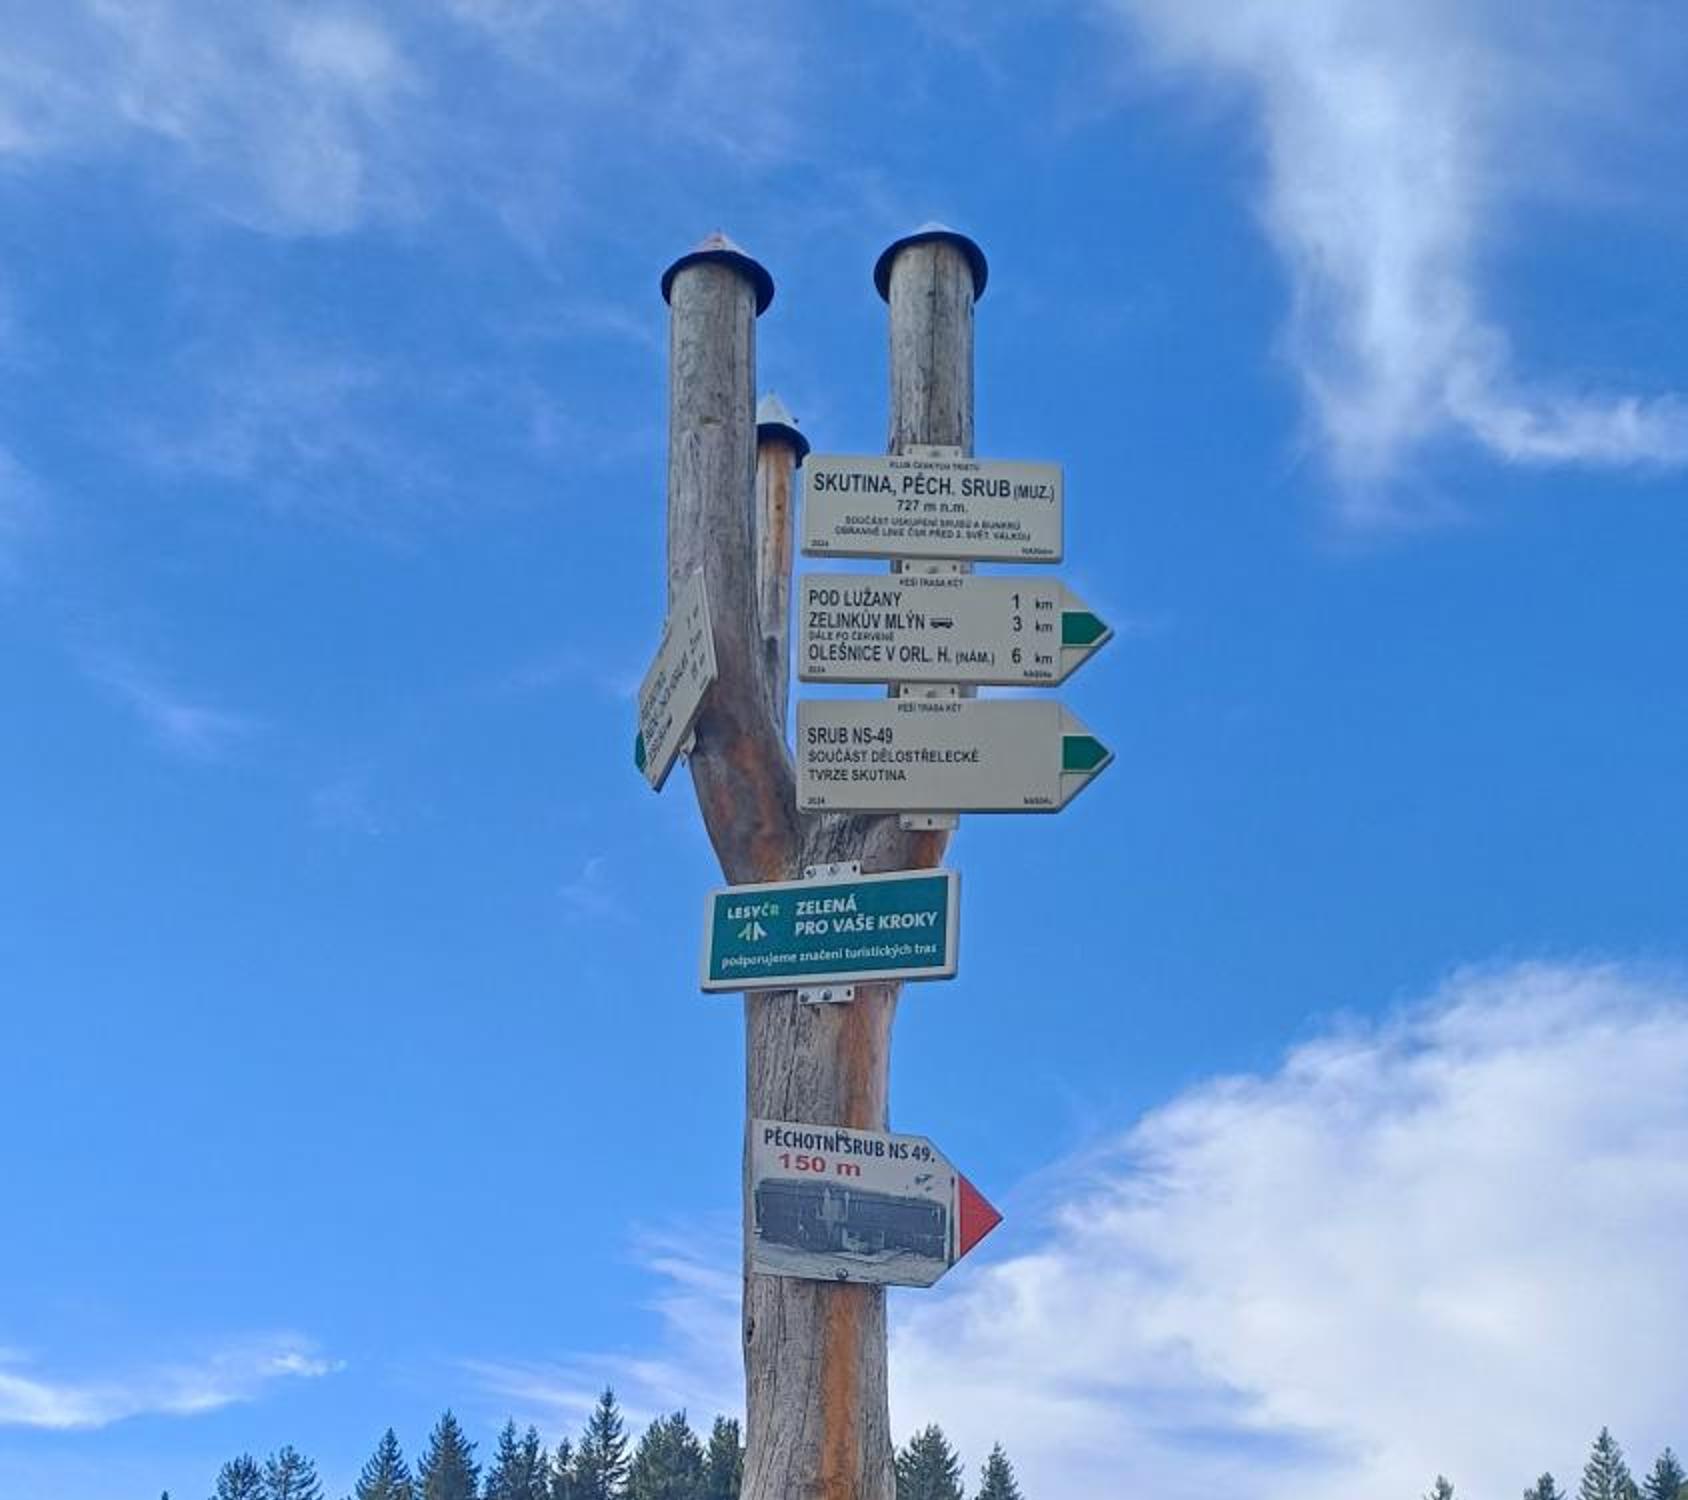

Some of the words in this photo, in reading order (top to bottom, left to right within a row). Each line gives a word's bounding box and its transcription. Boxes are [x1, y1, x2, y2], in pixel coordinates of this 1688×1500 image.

[813, 473, 897, 496] SKUTINA,
[903, 472, 955, 496] PĚCH.
[961, 479, 1011, 498] SRUB
[1013, 484, 1055, 503] (MUZ.)
[897, 500, 919, 512] 727
[923, 503, 937, 512] m
[940, 503, 968, 513] n.m.
[845, 515, 889, 525] SOUČÁST
[809, 589, 840, 606] POD
[843, 587, 902, 606] LUŽANY
[1012, 594, 1020, 609] 1
[1035, 601, 1053, 610] km
[808, 609, 881, 629] ZELINKŮV
[885, 610, 925, 629] MLÝN
[1013, 617, 1023, 632] 3
[1035, 623, 1053, 632] km
[809, 630, 834, 640] DÁLE
[836, 631, 849, 640] PO
[809, 642, 881, 661] OLEŠNICE
[885, 645, 896, 660] V
[899, 645, 932, 662] ORL.
[937, 647, 951, 661] H.
[955, 649, 995, 665] (NÁM.)
[1012, 648, 1022, 664] 6
[1035, 655, 1053, 664] km
[807, 728, 848, 744] SRUB
[852, 728, 894, 744] NS-49
[808, 747, 867, 763] SOUČÁST
[871, 748, 980, 763] DĚLOSTŘELECKÉ
[808, 769, 848, 781] TVRZE
[851, 769, 906, 782] SKUTINA
[796, 894, 857, 916] ZELENÁ
[795, 922, 829, 936] PRO
[834, 914, 875, 933] VAŠE
[879, 911, 937, 930] KROKY
[721, 953, 797, 970] podporujeme
[800, 948, 843, 962] značení
[845, 942, 912, 960] turistických
[914, 944, 937, 954] tras
[764, 1126, 840, 1153] PĚCHOTNÍ
[844, 1137, 886, 1157] SRUB
[889, 1146, 909, 1160] NS
[912, 1147, 935, 1163] 49.
[778, 1152, 826, 1173] 150
[836, 1163, 861, 1177] m
